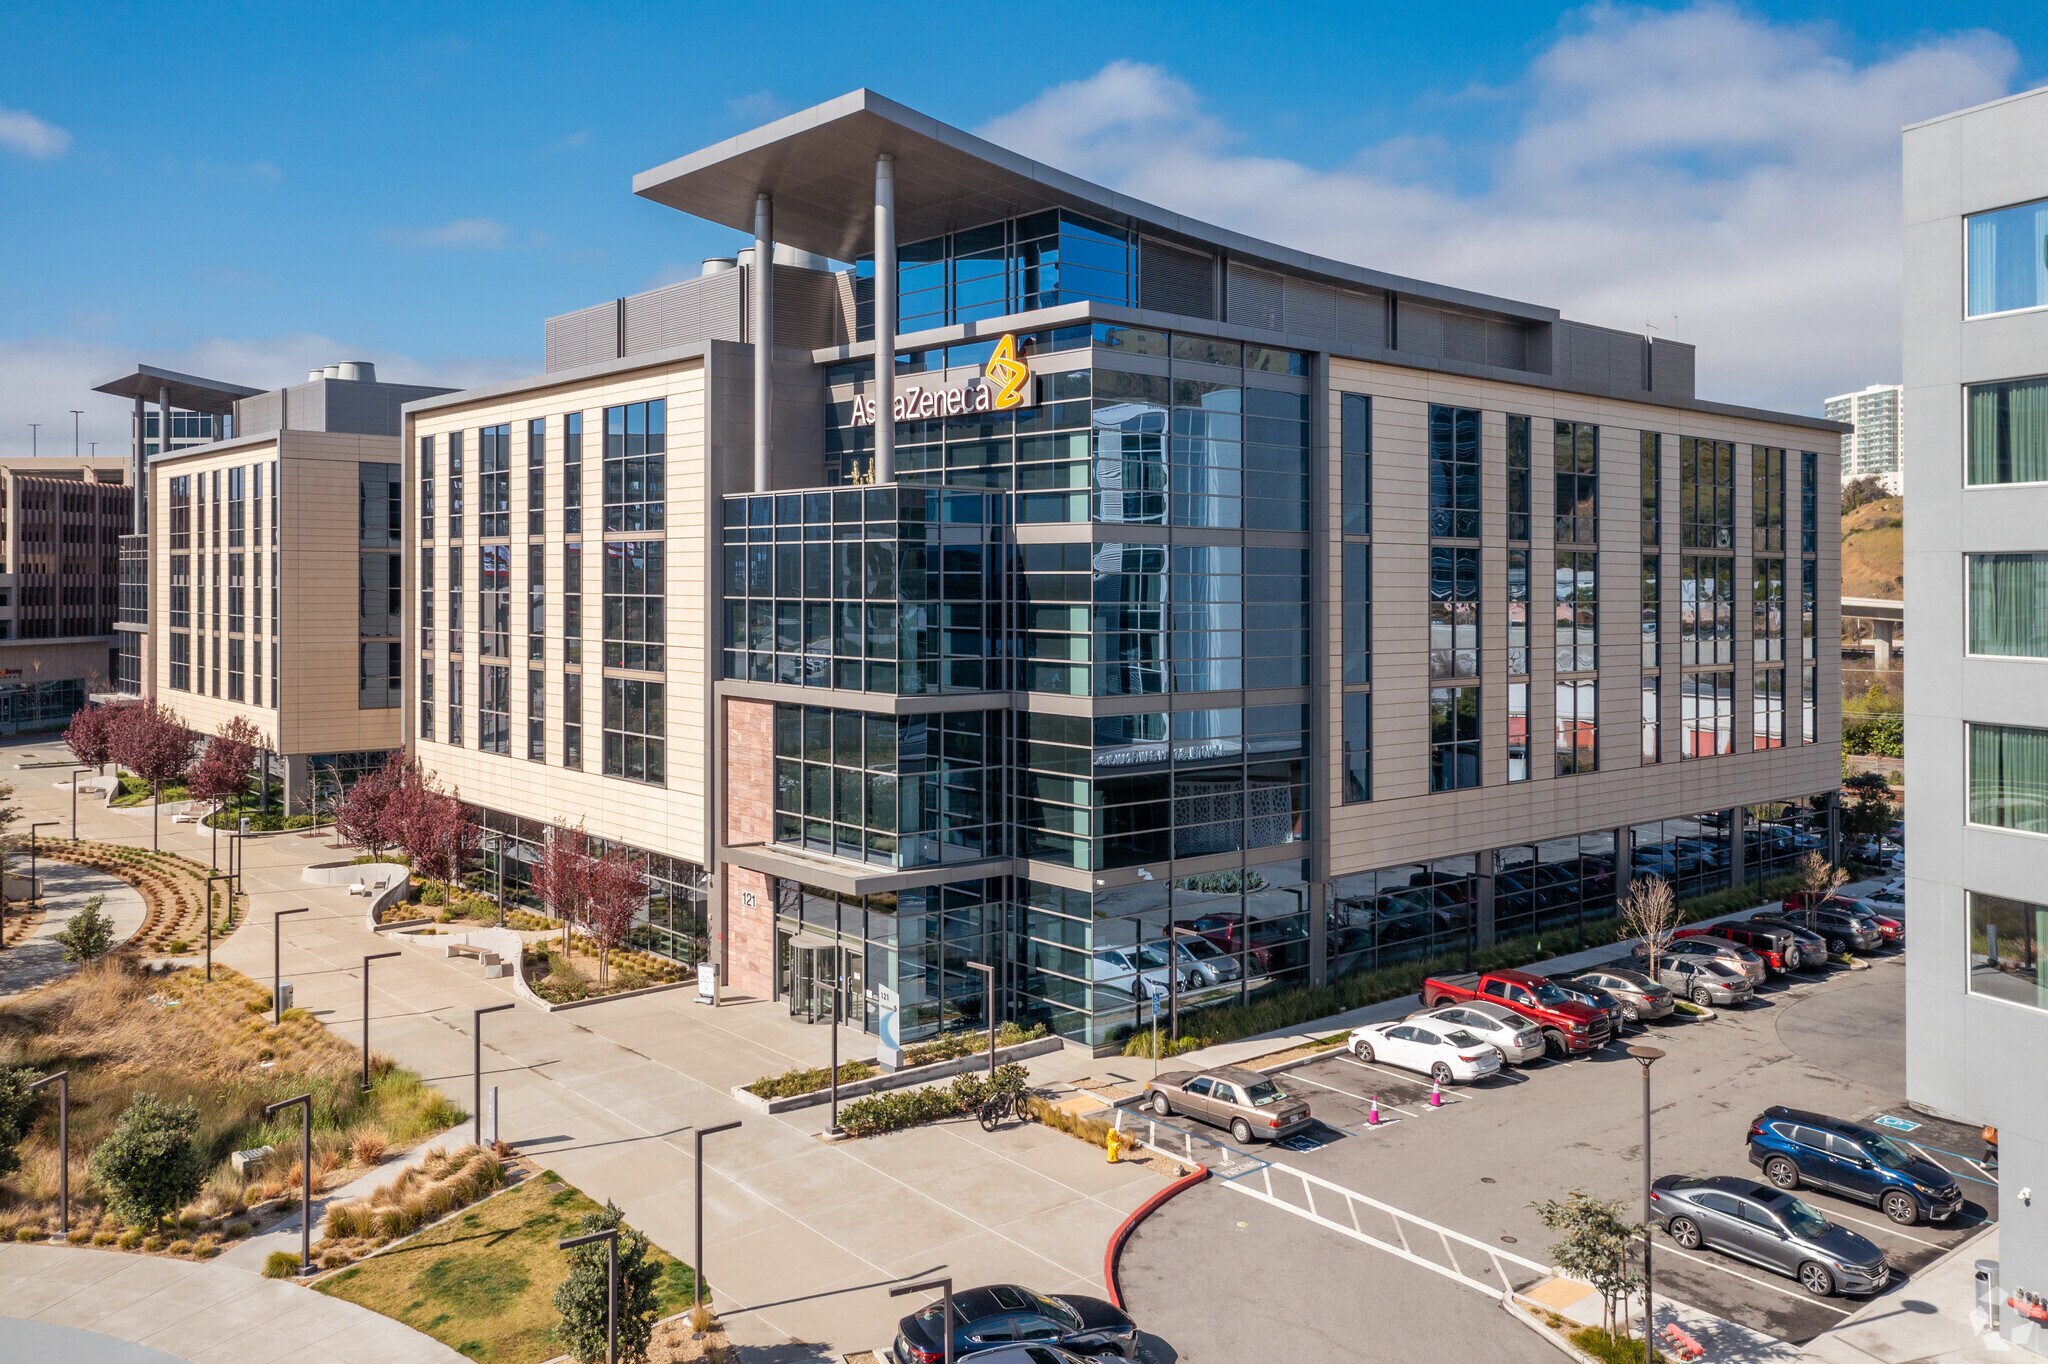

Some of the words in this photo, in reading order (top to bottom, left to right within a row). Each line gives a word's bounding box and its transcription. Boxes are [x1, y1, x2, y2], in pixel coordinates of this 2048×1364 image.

[851, 384, 991, 426] AsaZeneca
[742, 892, 756, 908] 121
[880, 992, 889, 1001] 121
[1217, 1159, 1236, 1167] NO
[1221, 1160, 1261, 1177] PARKING
